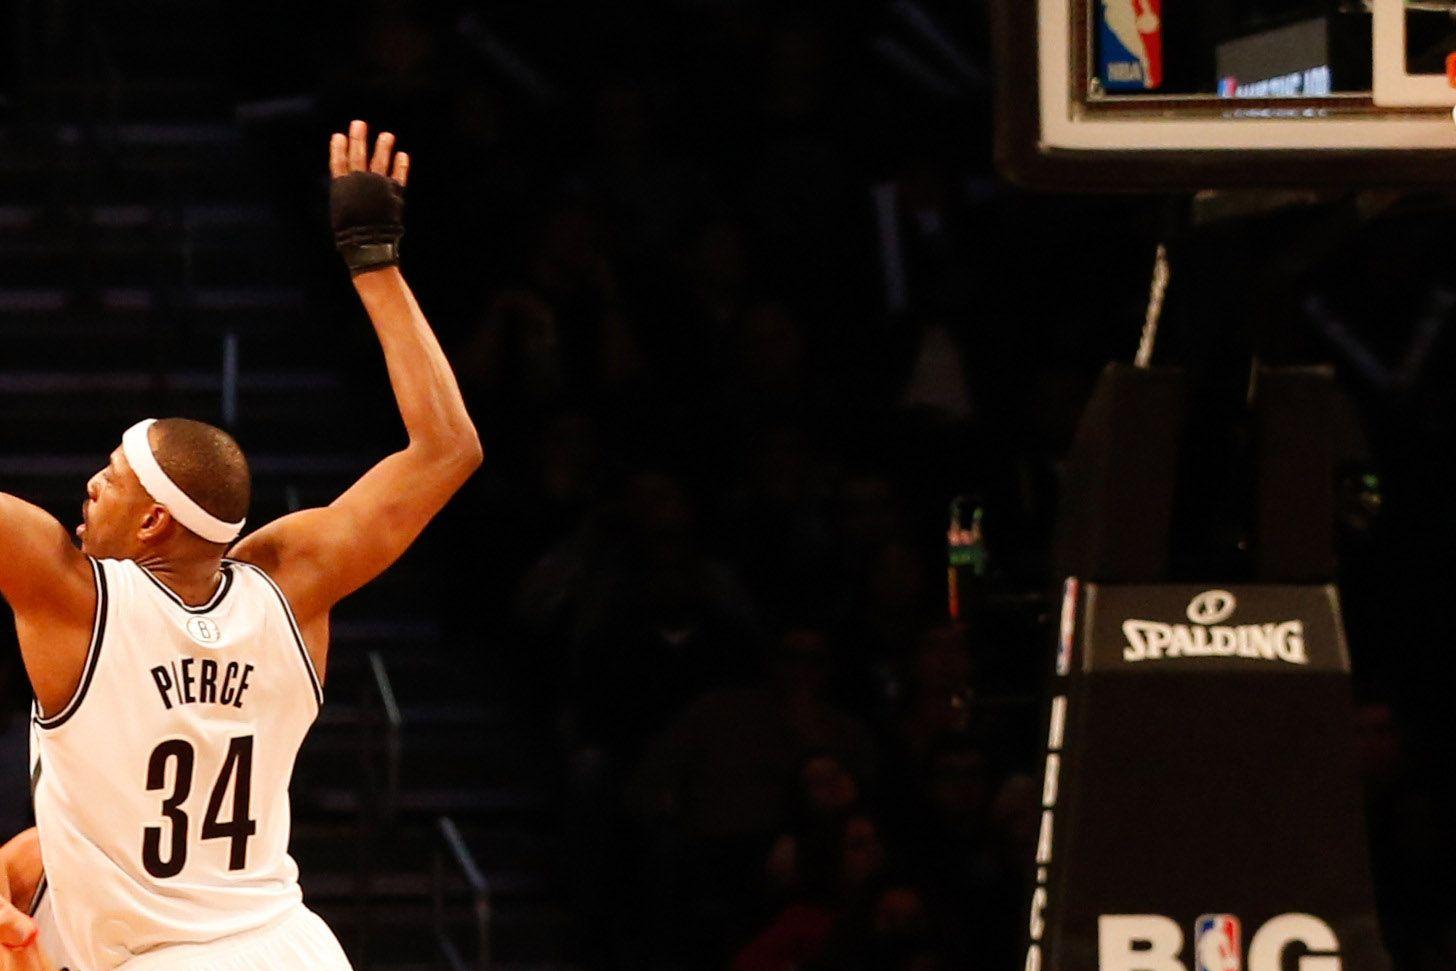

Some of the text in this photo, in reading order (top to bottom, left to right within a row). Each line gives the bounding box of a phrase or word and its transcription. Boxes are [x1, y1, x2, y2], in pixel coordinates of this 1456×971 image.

[1122, 618, 1309, 665] SPALDING
[150, 657, 255, 709] PIERCE
[142, 734, 257, 879] 34
